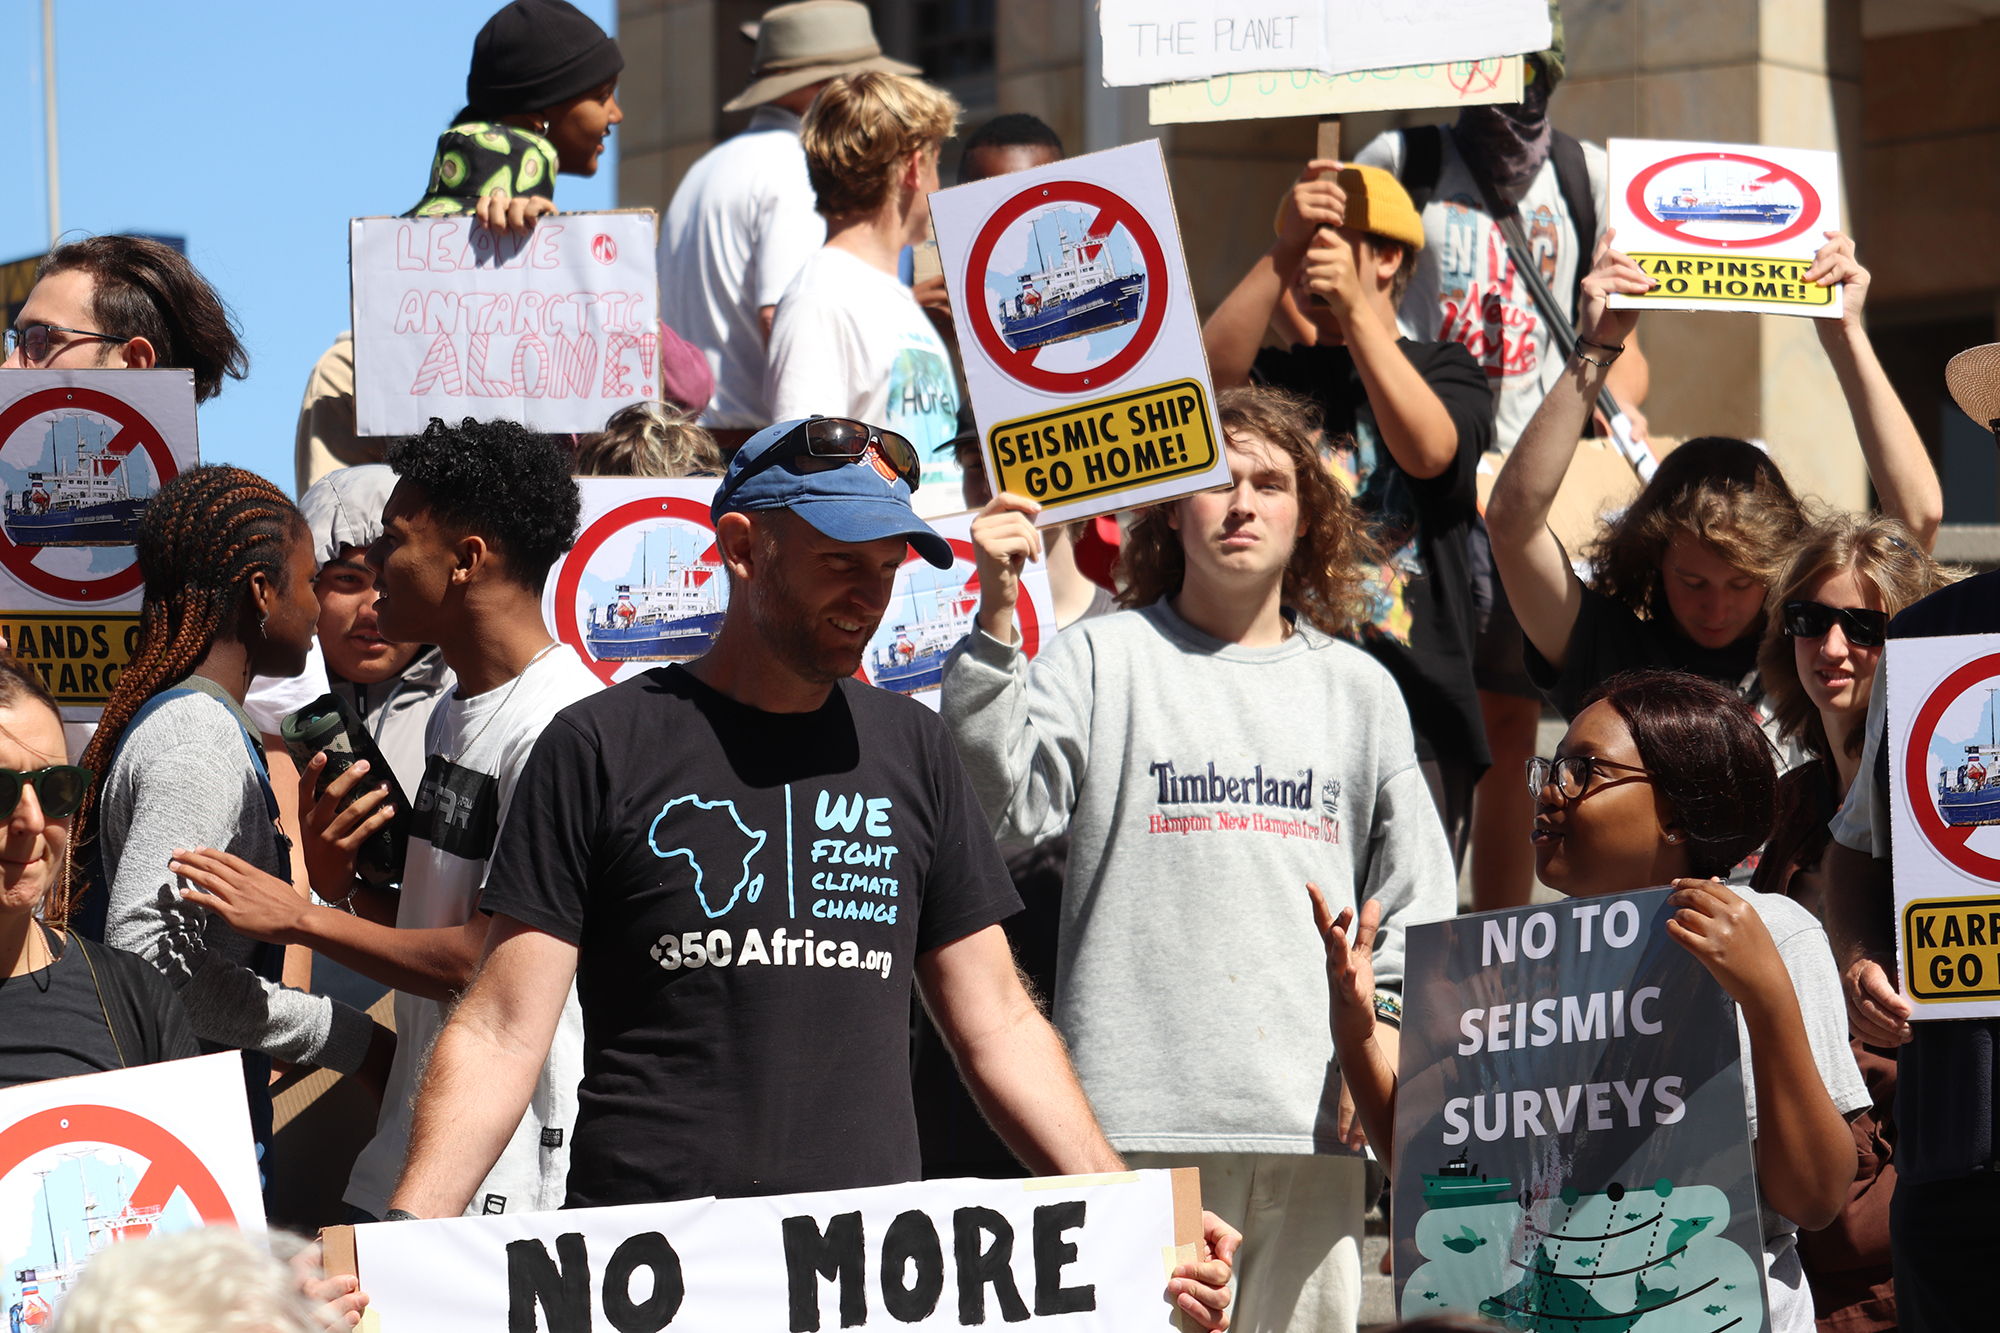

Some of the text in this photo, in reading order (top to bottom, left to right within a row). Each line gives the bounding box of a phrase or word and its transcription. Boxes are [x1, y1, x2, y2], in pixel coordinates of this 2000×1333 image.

[1128, 16, 1299, 56] THE PLANET
[395, 290, 643, 336] ANTARCTIC
[1702, 279, 1806, 300] HOME!
[410, 332, 657, 399] ALONE!
[998, 395, 1196, 467] SEISMIC SHIP
[1025, 433, 1188, 497] GO HOME!
[1149, 761, 1313, 811] Timberland
[815, 789, 893, 837] WE
[1149, 811, 1340, 845] Hampton New Hampshire USA
[811, 839, 899, 870] FIGHT
[811, 872, 899, 897] CLIMATE
[811, 899, 898, 925] CHANGE
[1481, 900, 1640, 967] NO TO
[1930, 953, 1983, 989] GO
[1457, 986, 1663, 1057] SEISMIC
[1442, 1075, 1687, 1146] SURVEYS
[506, 1200, 1097, 1333] NO MORE
